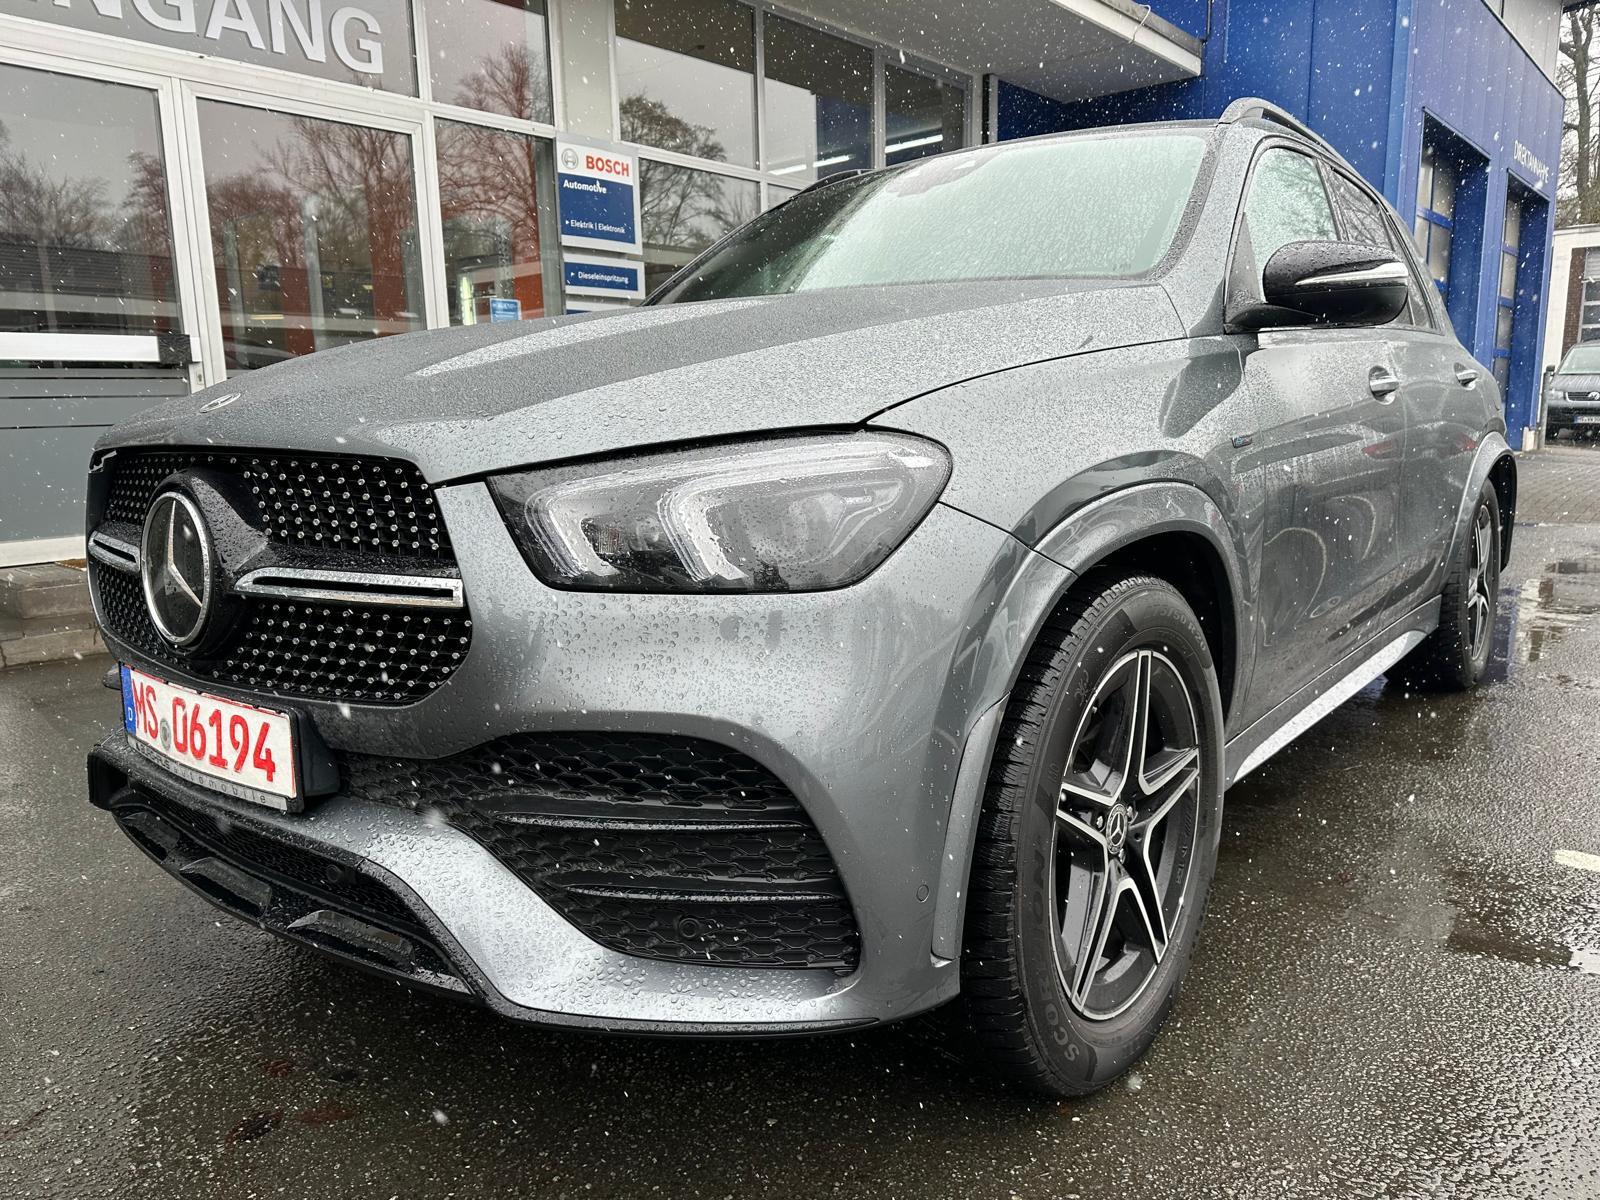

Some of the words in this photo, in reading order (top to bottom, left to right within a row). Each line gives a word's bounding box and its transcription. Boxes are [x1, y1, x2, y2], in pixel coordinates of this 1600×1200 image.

[585, 155, 630, 177] BOSCH
[563, 179, 607, 194] Automotive
[570, 219, 594, 229] Elektrik
[598, 223, 626, 234] Elektronik
[577, 271, 629, 285] Dieseleinspritzung
[127, 706, 133, 722] D
[132, 678, 158, 740] MS
[172, 696, 276, 783] 06194
[173, 765, 266, 804] automobile
[1033, 849, 1080, 1062] SCORON
